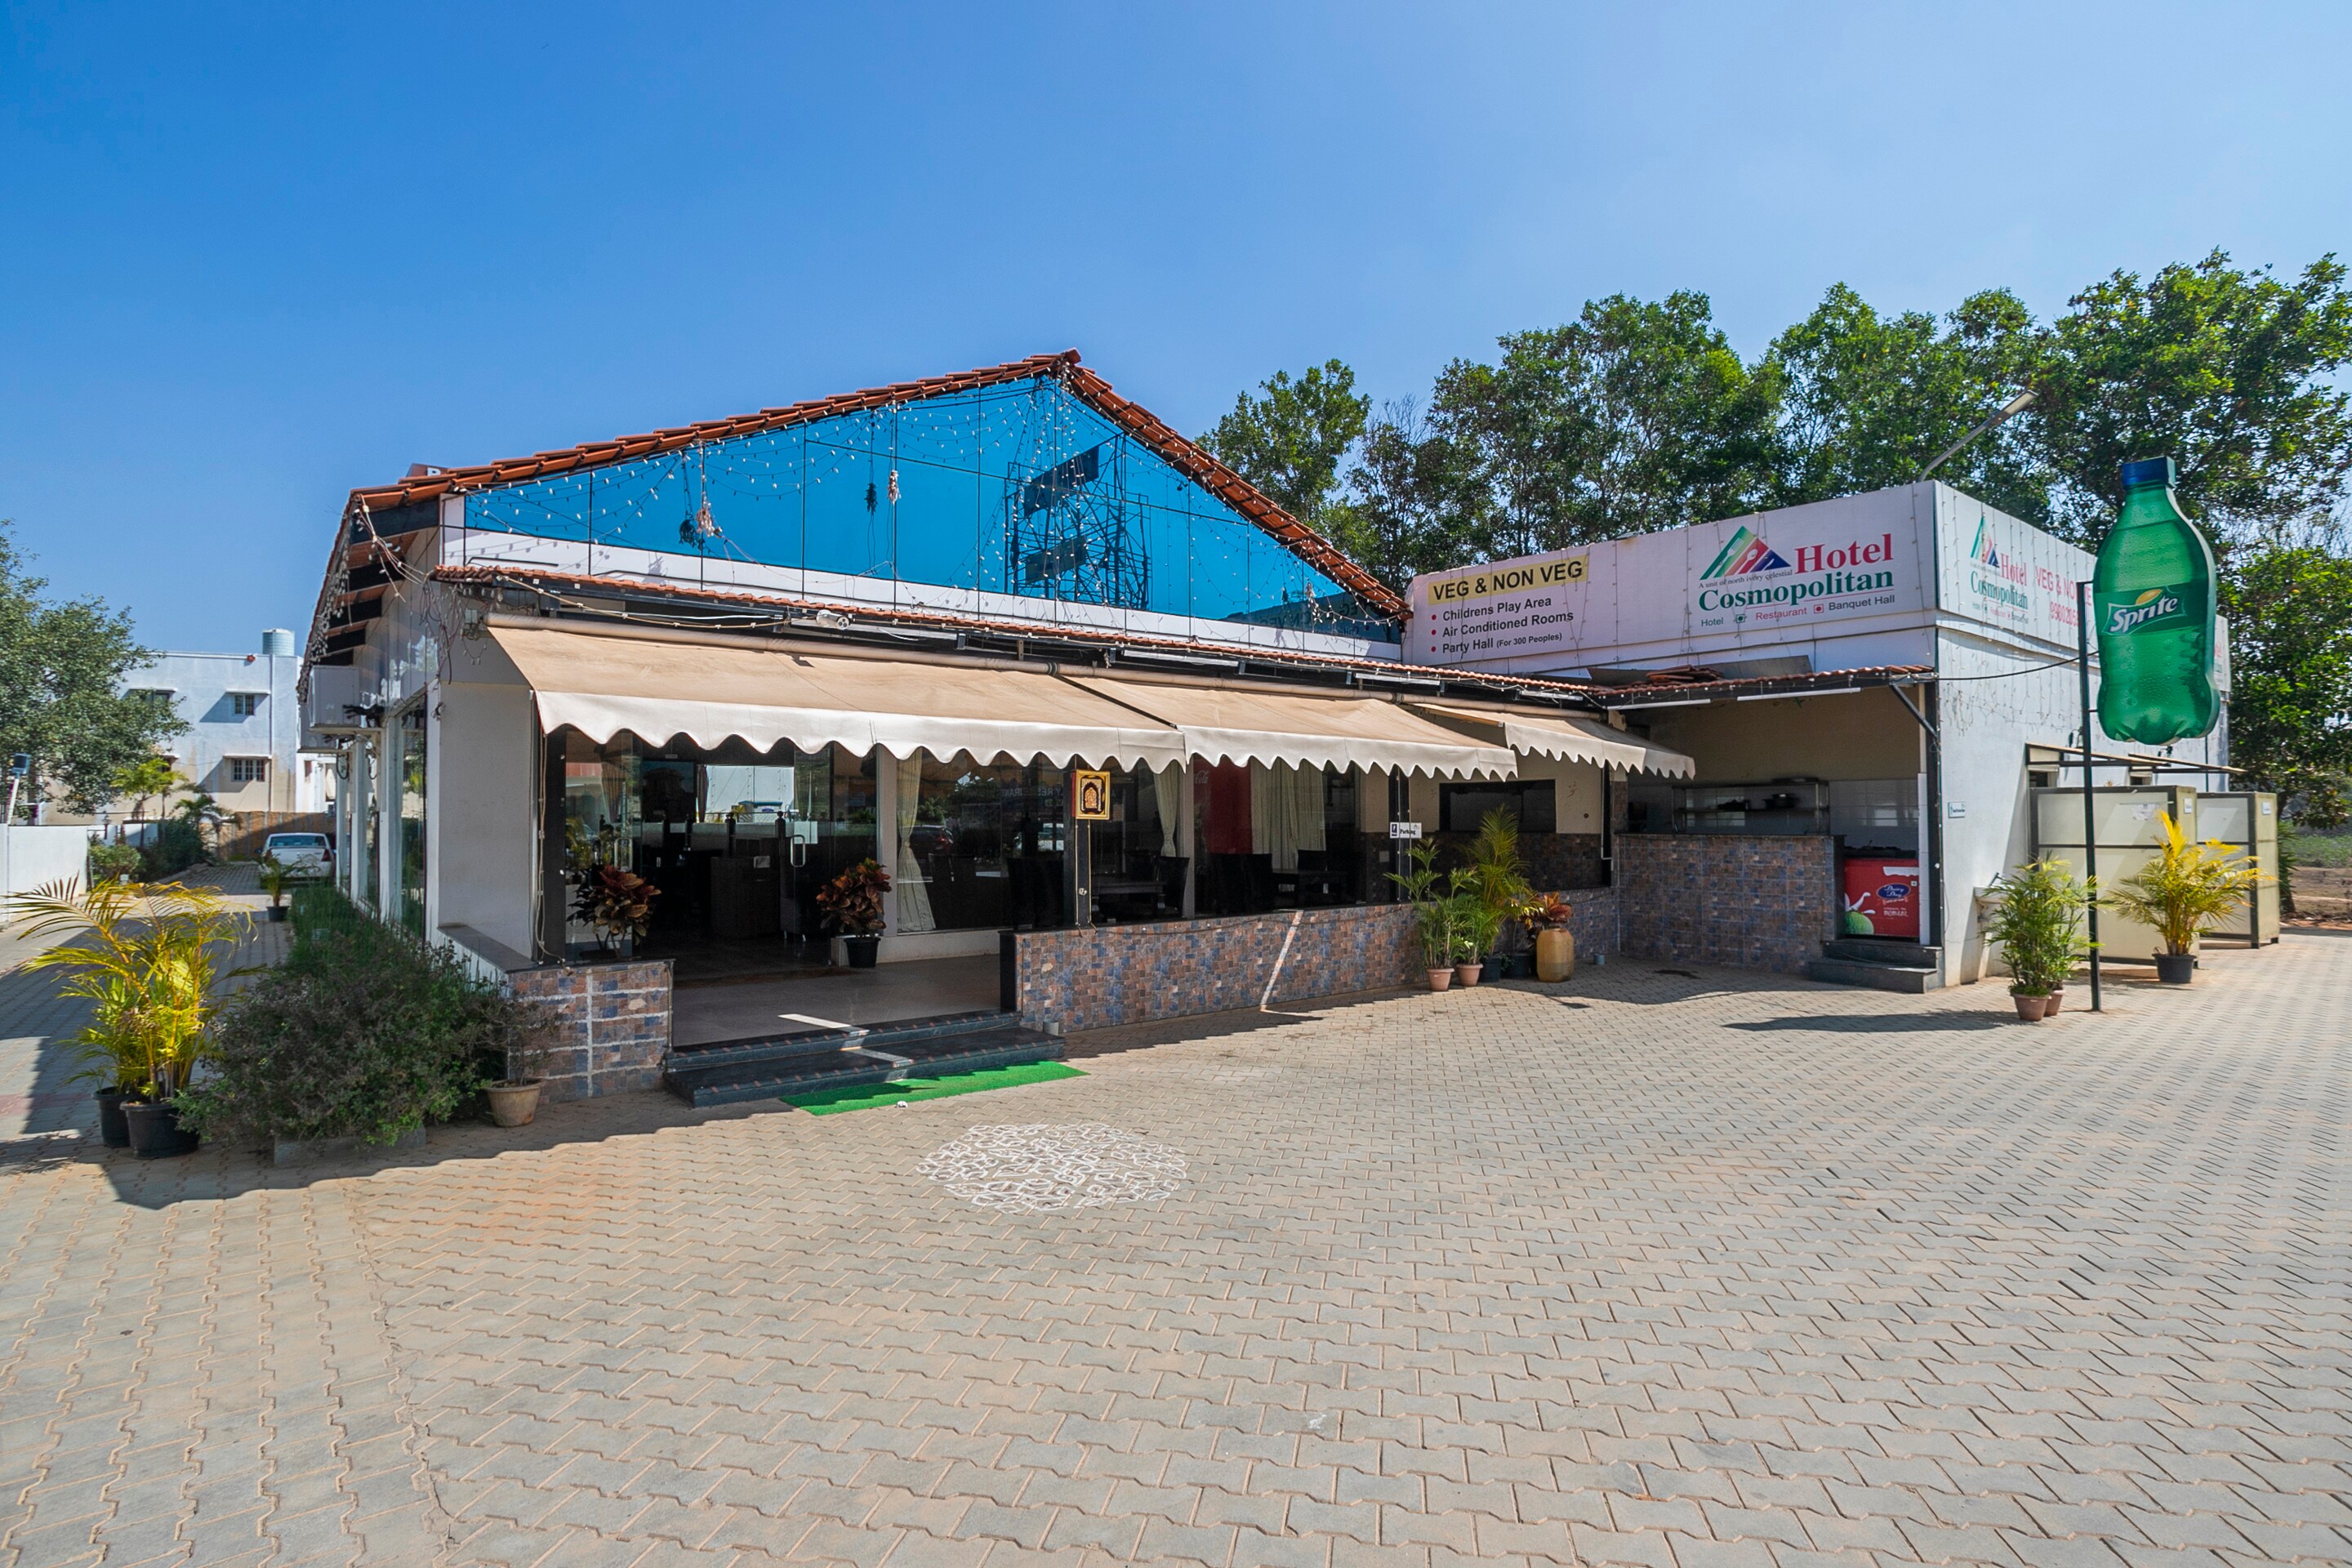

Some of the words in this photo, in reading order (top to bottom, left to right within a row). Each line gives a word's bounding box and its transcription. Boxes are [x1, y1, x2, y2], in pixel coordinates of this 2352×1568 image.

[1794, 533, 1894, 574] Hotel
[2000, 552, 2027, 586] Hotel
[1433, 581, 1468, 601] VEG
[1475, 577, 1487, 594] &
[1494, 569, 1534, 590] NON
[1540, 560, 1583, 582] VEG
[1699, 571, 1895, 611] Cosmopolitan
[1727, 577, 1745, 585] north
[1971, 571, 2029, 610] Cosmopolitan
[2036, 565, 2053, 591] VEG
[2063, 577, 2077, 599] NO
[1442, 627, 1458, 638] Air
[1461, 617, 1528, 635] Conditioned
[1532, 612, 1574, 626] Rooms
[1443, 606, 1494, 621] Childrens
[1497, 602, 1521, 613] Play
[1524, 598, 1552, 609] Area
[1701, 617, 1724, 627] Hotel
[1756, 608, 1807, 621] Restaurant
[1829, 598, 1872, 611] Banquet
[1874, 595, 1895, 605] Hall
[2109, 595, 2179, 633] Sprite
[1442, 643, 1469, 654] Party
[1472, 638, 1494, 650] Hall
[1497, 639, 1511, 648] (For
[1513, 637, 1526, 645] 300
[1529, 633, 1562, 644] Peoples)
